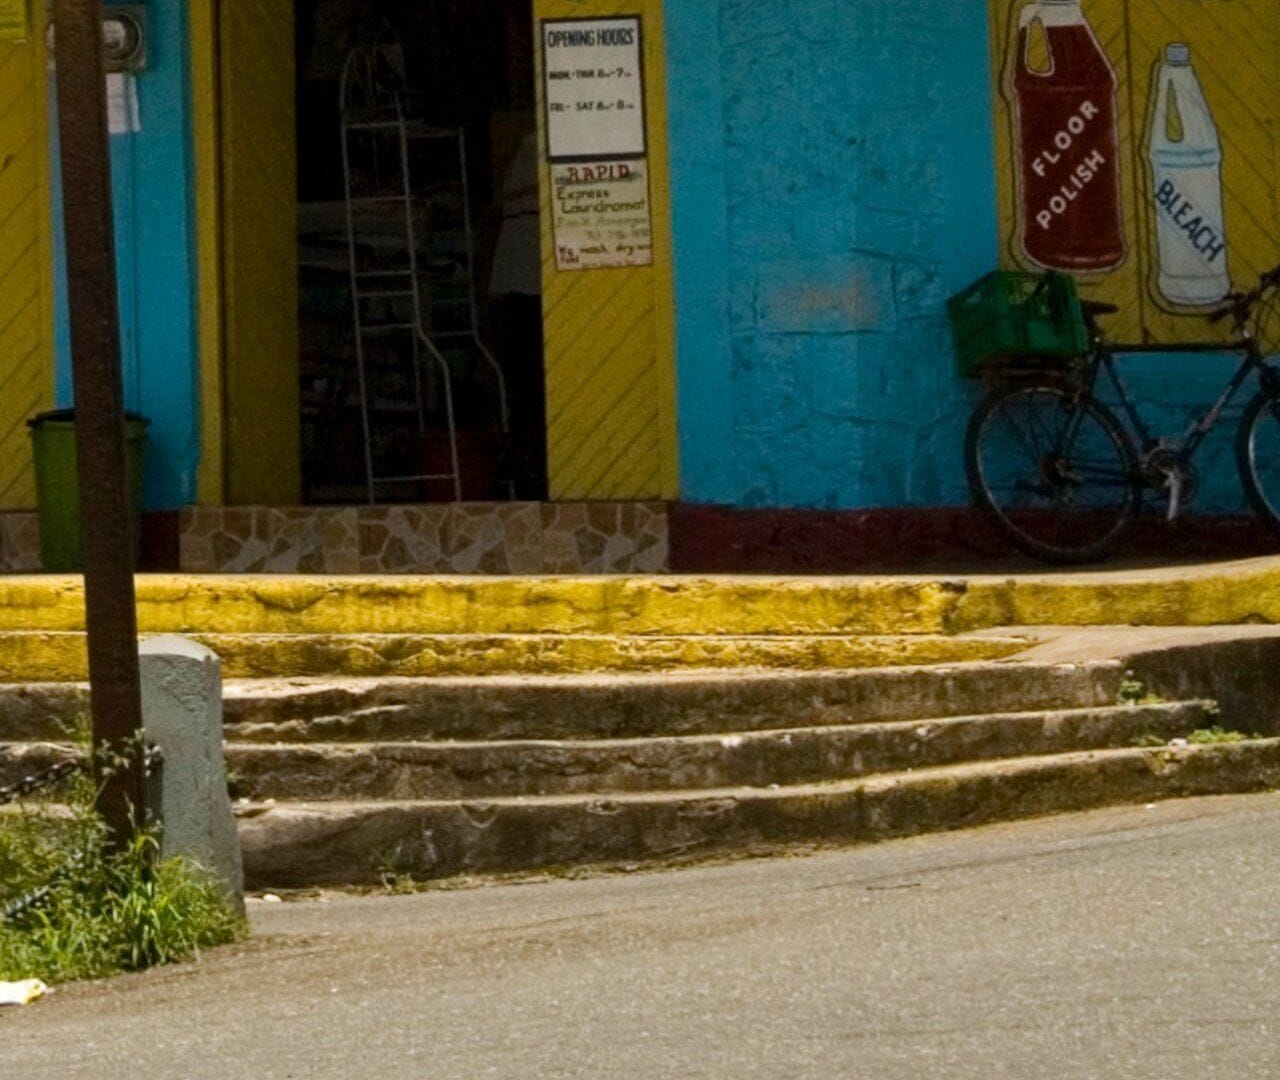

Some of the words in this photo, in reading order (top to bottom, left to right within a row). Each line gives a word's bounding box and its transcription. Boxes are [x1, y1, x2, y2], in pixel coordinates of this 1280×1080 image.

[547, 30, 595, 48] OPENING
[596, 27, 634, 47] HOURS
[1031, 99, 1100, 178] FLOOR
[556, 186, 610, 203] Express
[566, 164, 631, 183] RAPID
[1035, 149, 1107, 232] POLISH
[1154, 178, 1225, 264] BLEACH
